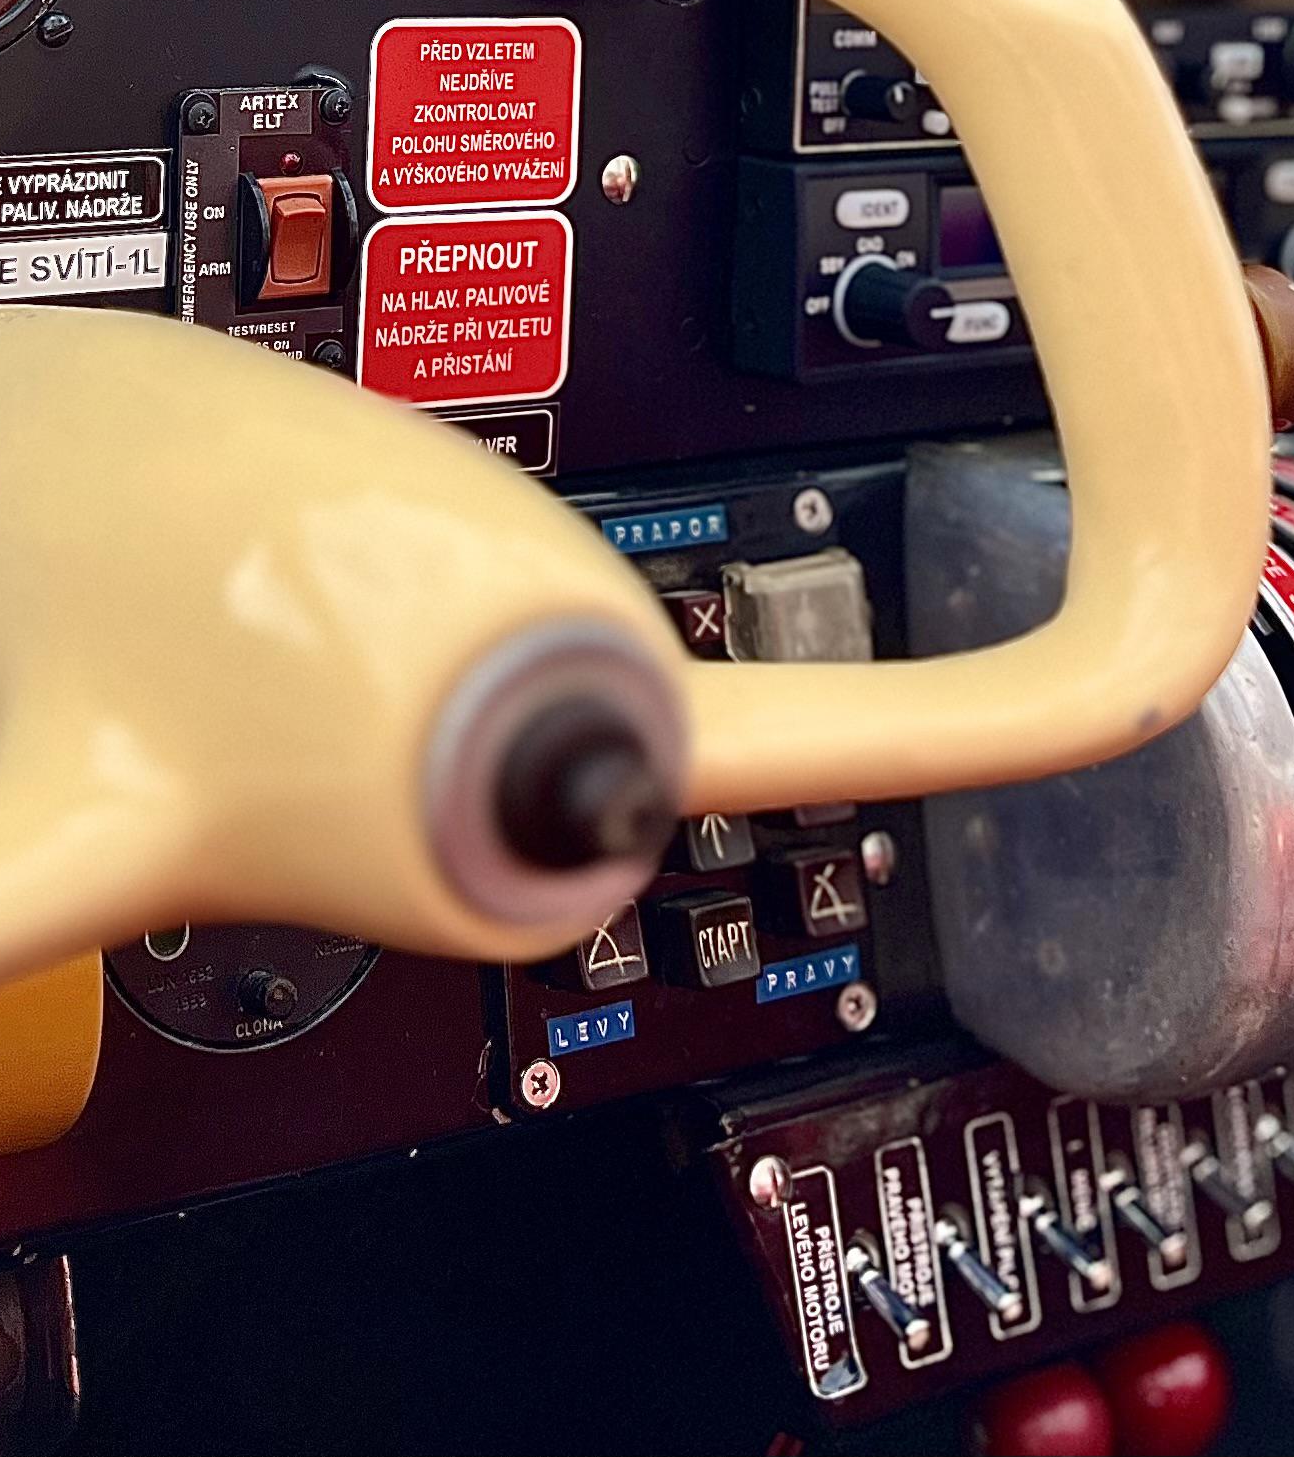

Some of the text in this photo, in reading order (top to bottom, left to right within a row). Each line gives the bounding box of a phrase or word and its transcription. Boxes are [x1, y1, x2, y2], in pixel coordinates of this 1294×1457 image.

[420, 40, 536, 61] PŘED VZLETEM
[833, 29, 877, 49] COMM
[439, 69, 514, 92] NEJDŘÍVE
[240, 94, 300, 112] ARTEX
[413, 102, 536, 123] ZKONTROLOVAT
[252, 113, 284, 130] ELT
[392, 128, 555, 155] POLOHU SMĚROVÉHO
[7, 168, 130, 195] VYPRÁZDNIT
[378, 156, 565, 186] A VÝŠKOVÉHO VYVÁŽENÍ
[1, 201, 59, 223] PALIV.
[65, 193, 143, 219] NÁDRŽE
[203, 205, 225, 220] ON
[181, 159, 200, 325] EMERGENCY USE ONLY
[30, 245, 161, 282] SVÍTÍ-1L
[198, 261, 231, 277] ARM
[399, 240, 539, 275] PŘEPNOUT
[381, 279, 551, 313] NA HLAV. PALIVOVÉ
[227, 321, 296, 337] TEST/RESET
[375, 316, 552, 348] NÁDRŽE PŘI VZLETU
[413, 347, 514, 379] A PŘISTÁNÍ
[485, 435, 517, 454] VFR
[614, 515, 721, 545] PRAPOR
[766, 955, 855, 993] PRAVY
[555, 1010, 631, 1048] LEVY
[790, 1202, 830, 1372] LEVÉHO MOTORU
[815, 1225, 846, 1337] PŘÍSTROJE
